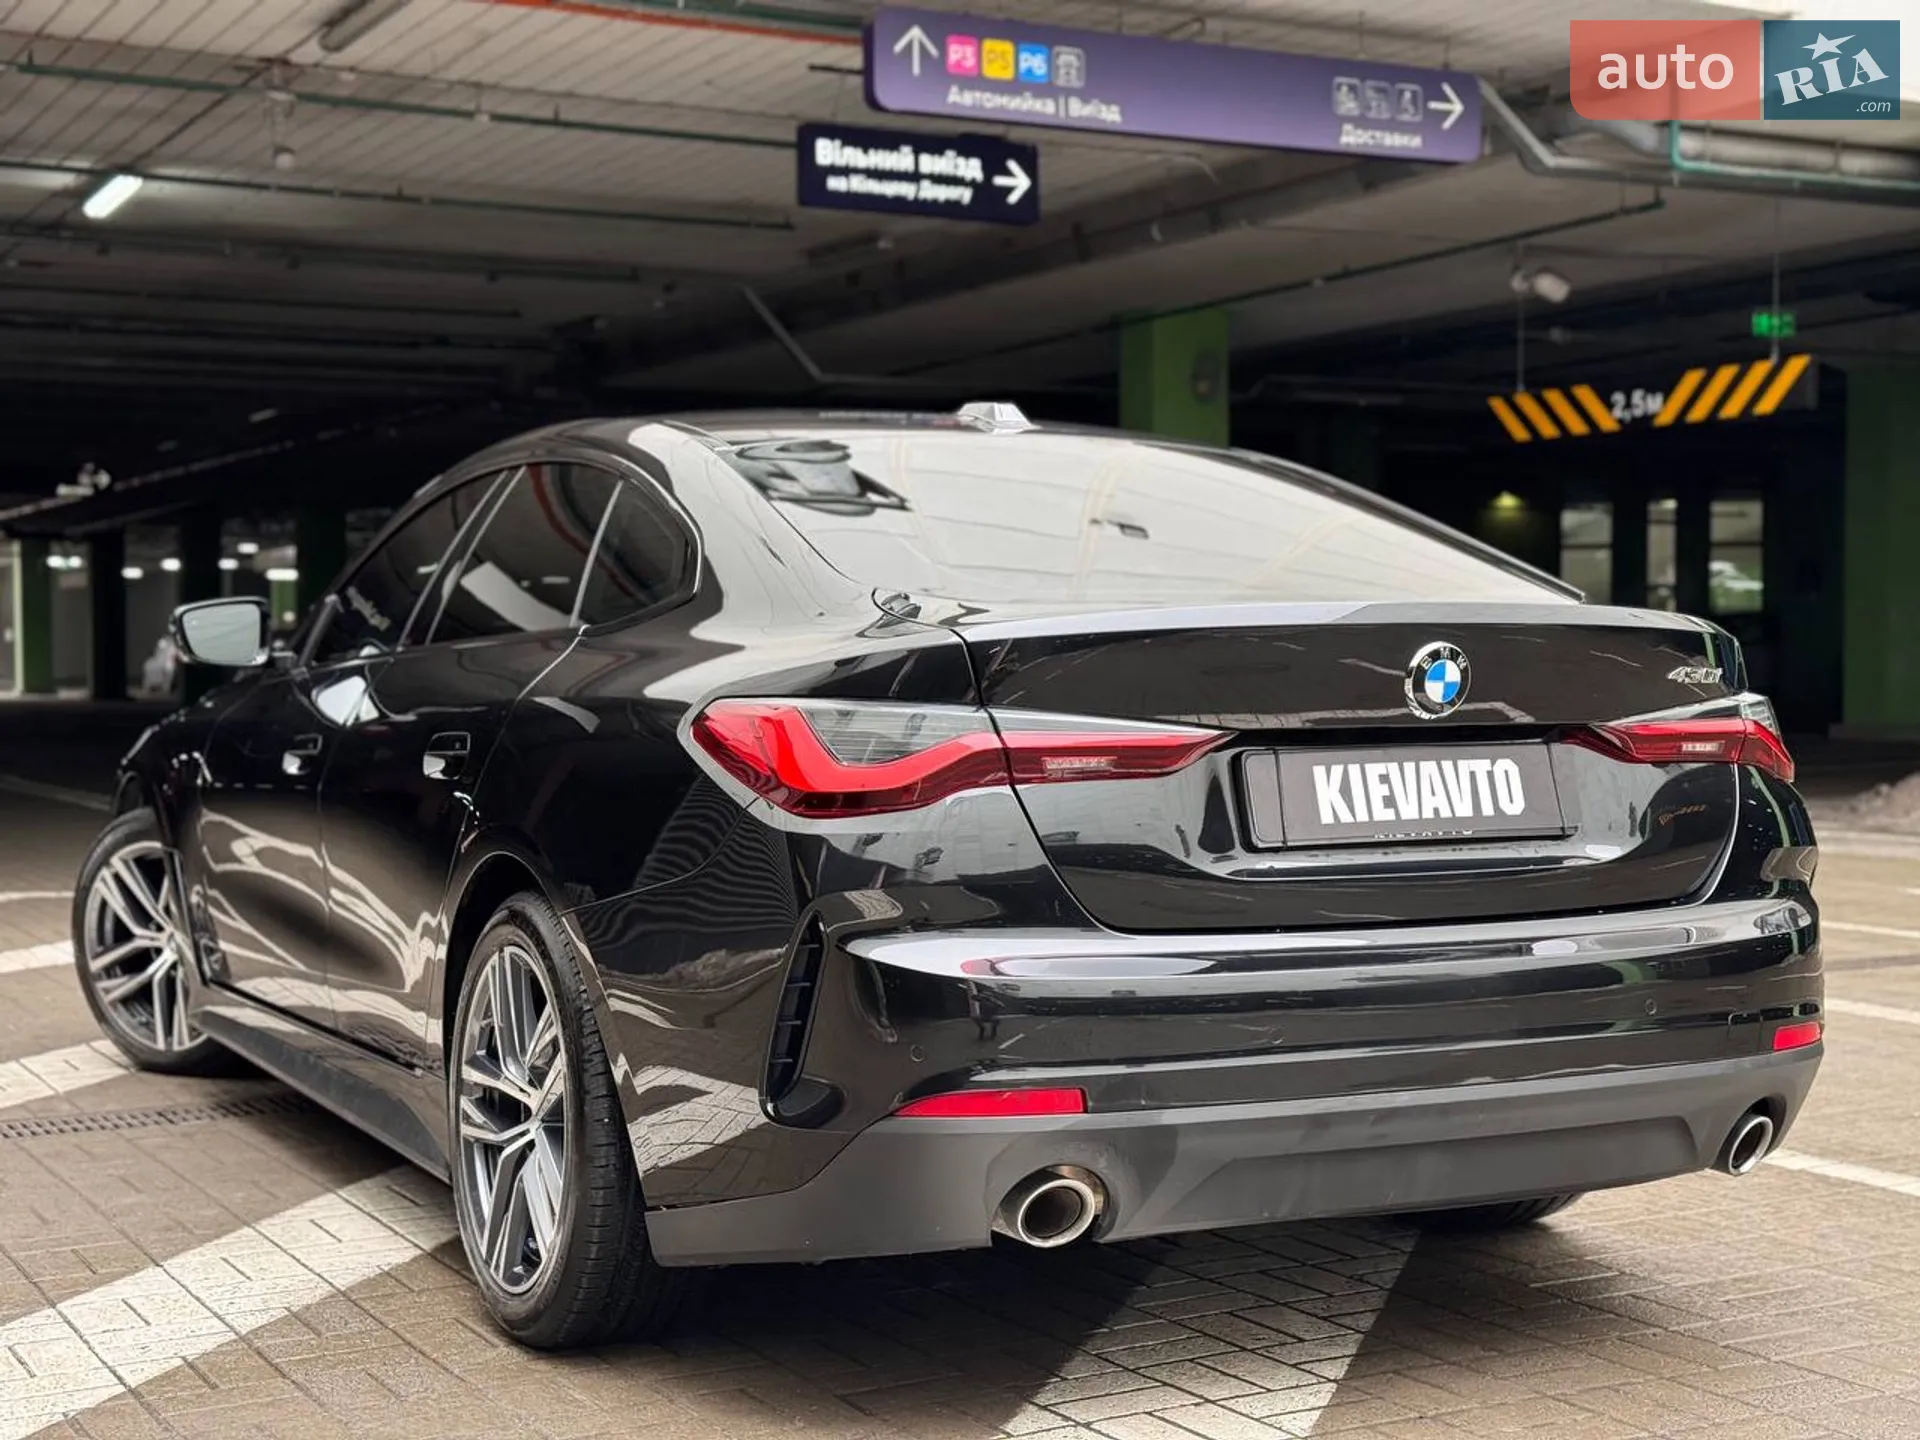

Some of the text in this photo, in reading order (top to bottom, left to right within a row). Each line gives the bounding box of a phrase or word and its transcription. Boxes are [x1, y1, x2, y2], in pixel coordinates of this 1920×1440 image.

[1018, 50, 1048, 76] P6
[946, 84, 1056, 115] Автомийка
[1068, 96, 1122, 123] Виїзд
[1339, 123, 1422, 148] Доставки
[814, 137, 984, 183] Вільний виїзд
[1420, 646, 1468, 670] BMW
[1312, 758, 1526, 826] KIEVAVTO
